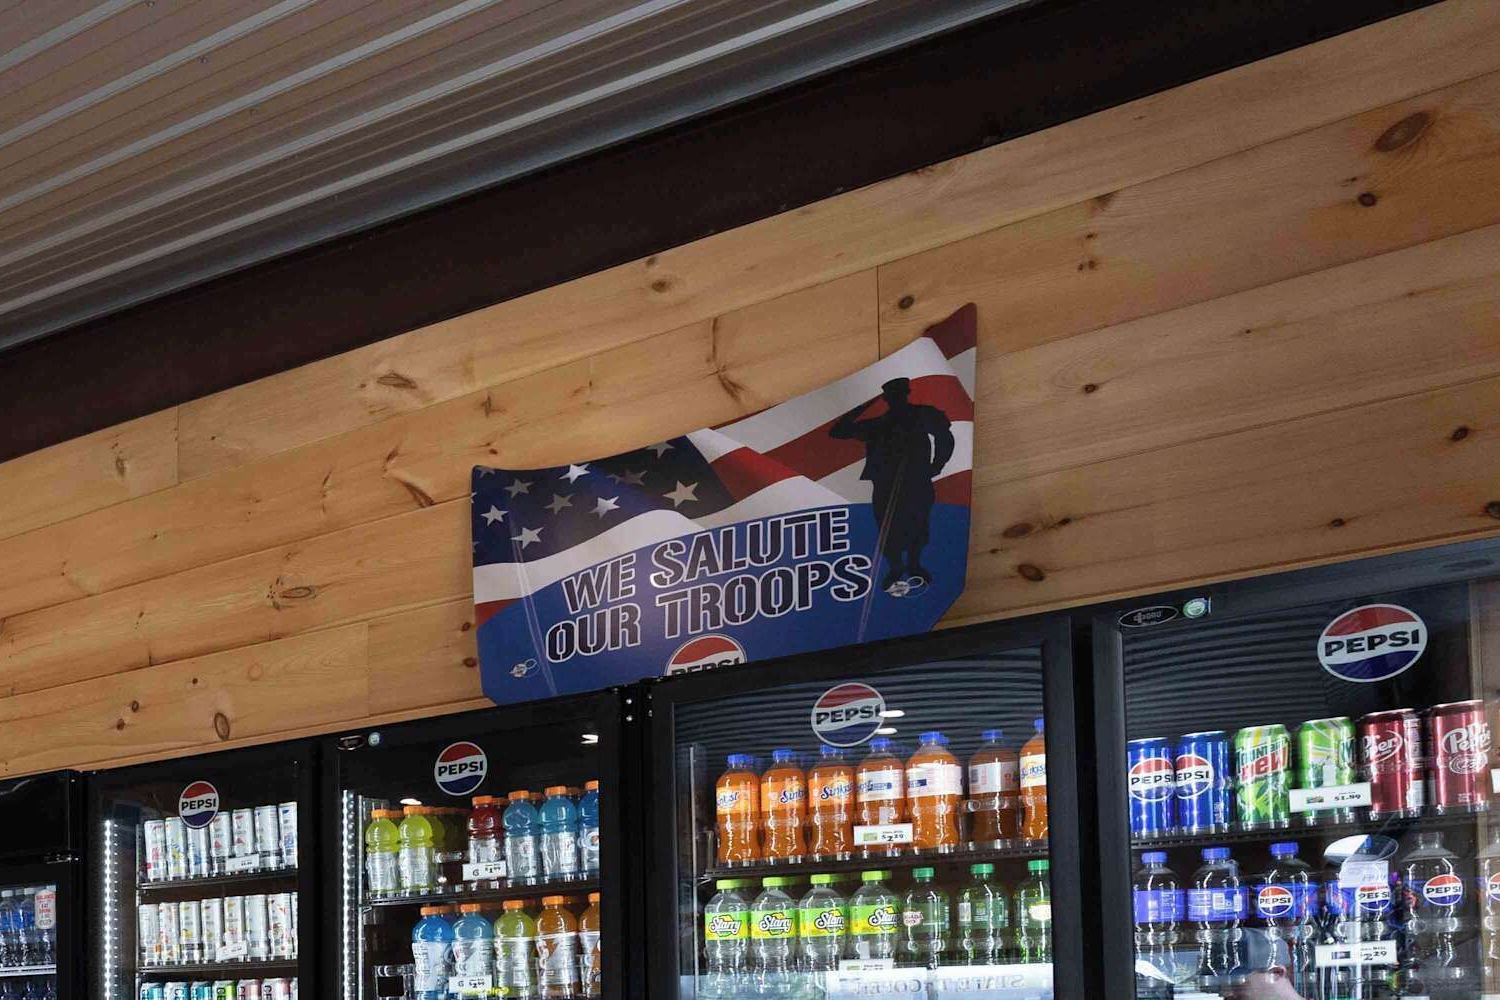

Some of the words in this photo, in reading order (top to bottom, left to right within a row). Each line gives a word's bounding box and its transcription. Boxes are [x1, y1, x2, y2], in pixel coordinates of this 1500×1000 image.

[562, 553, 636, 614] WE
[650, 508, 849, 589] SALUTE
[545, 604, 641, 663] OUR
[655, 554, 872, 639] TROOPS
[1324, 629, 1420, 657] PEPSI
[816, 704, 883, 725] PEPSI
[438, 760, 484, 777] PEPSI
[1177, 770, 1210, 782] EPSI
[1131, 774, 1172, 785] PEPS
[181, 798, 216, 811] PEPSI
[1426, 886, 1461, 894] PEPSI
[709, 915, 742, 934] Starry
[760, 913, 792, 934] Starry
